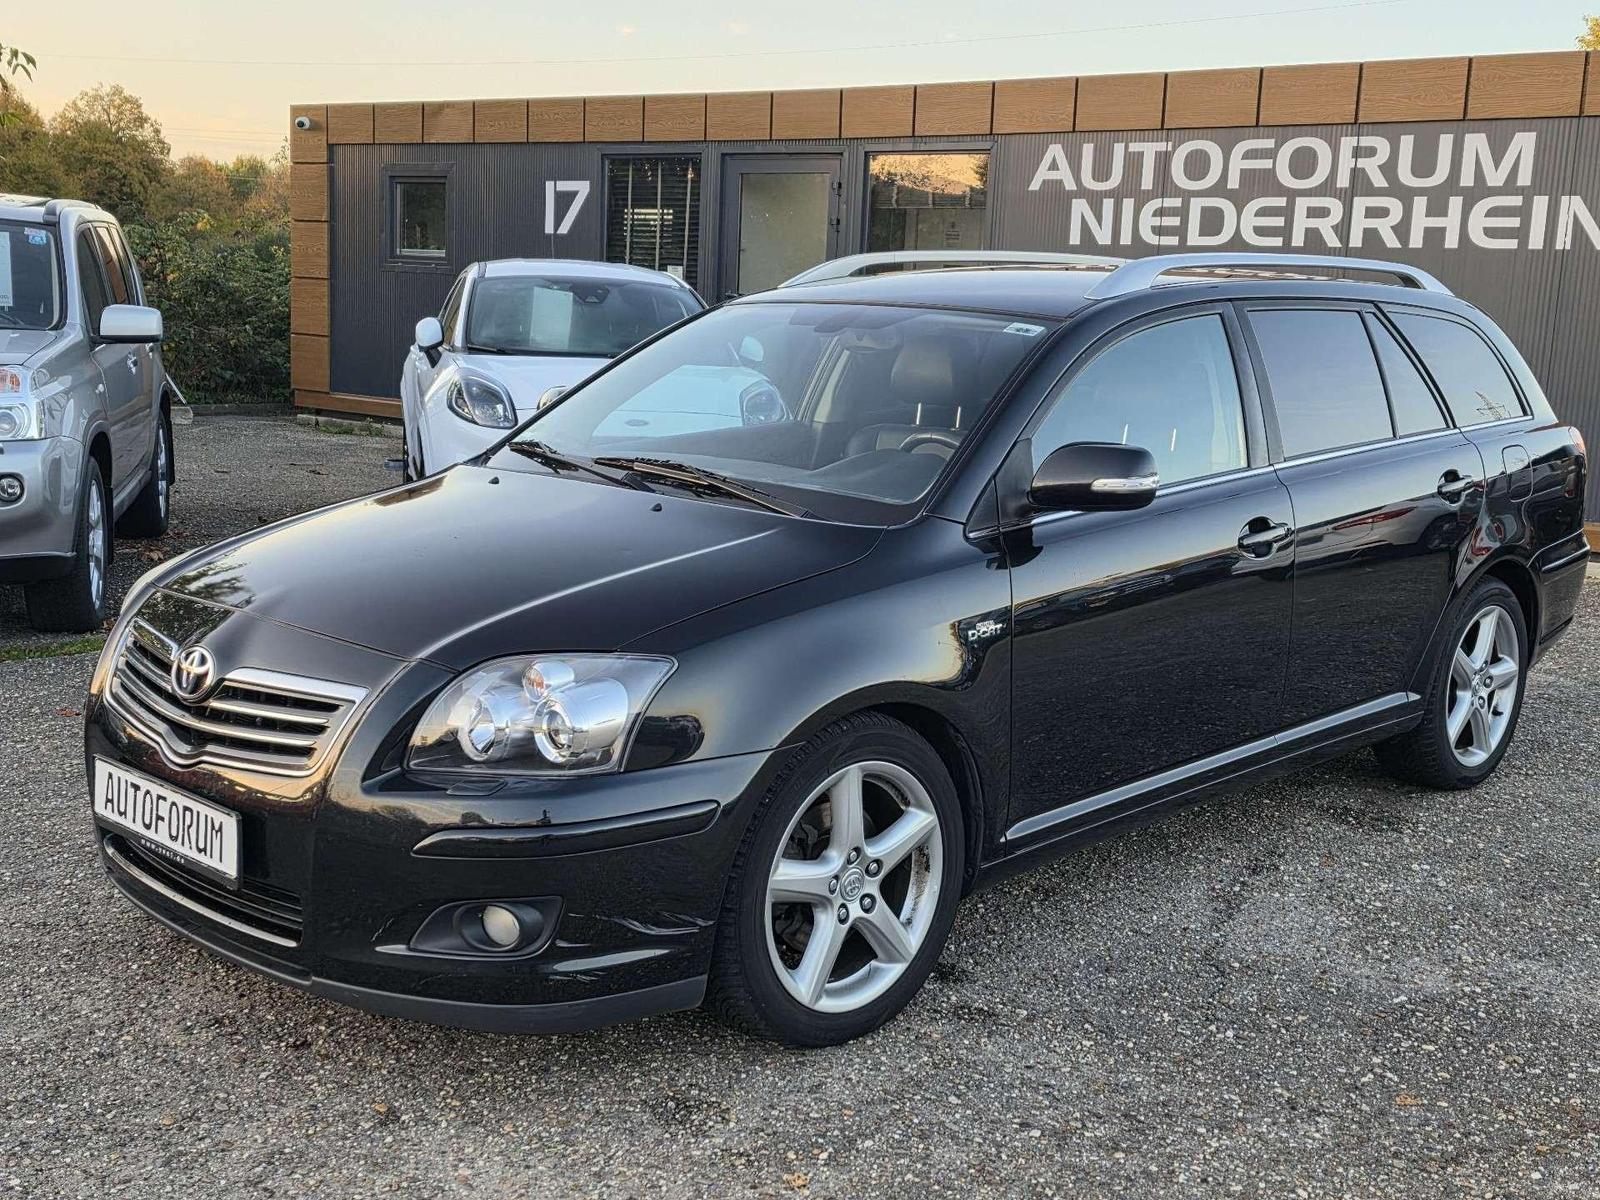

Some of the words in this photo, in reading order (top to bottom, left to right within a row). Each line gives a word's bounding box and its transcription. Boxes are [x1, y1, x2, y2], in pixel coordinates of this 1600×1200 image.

[1028, 132, 1537, 191] AUTOFORUM
[545, 181, 590, 234] 17
[1069, 195, 1600, 250] NIEDERRHEIN
[104, 771, 224, 864] AUTOFORUM
